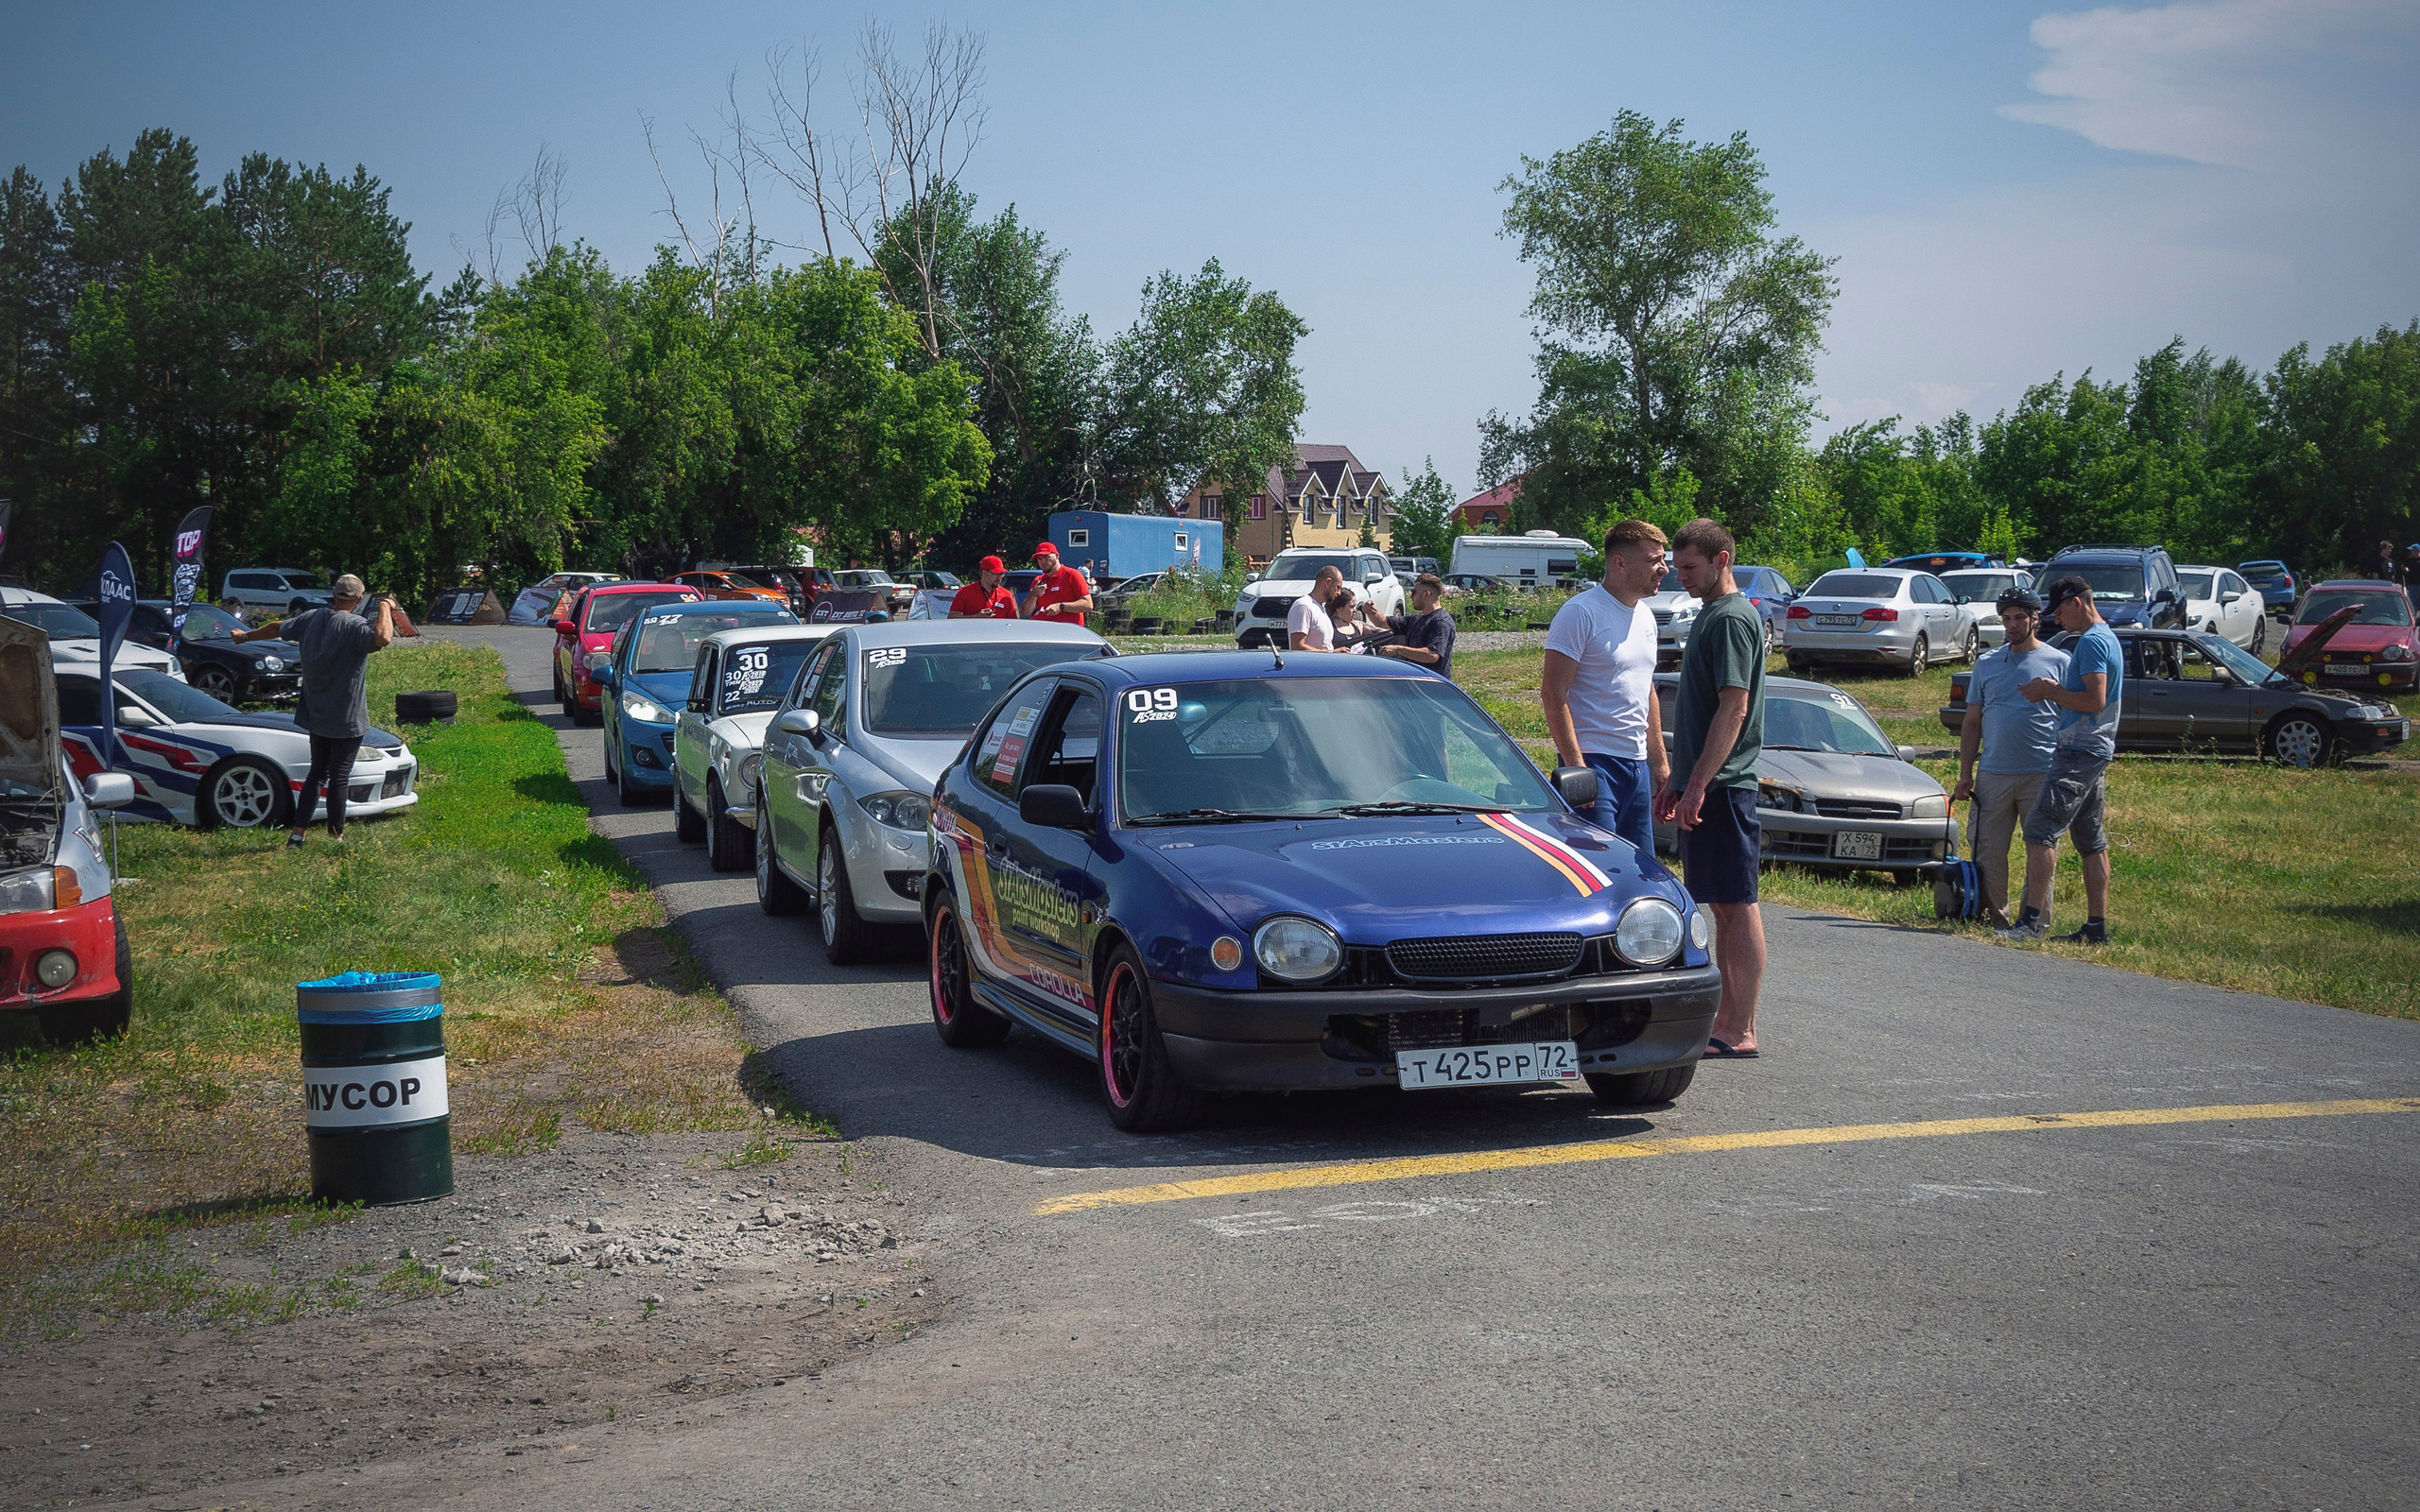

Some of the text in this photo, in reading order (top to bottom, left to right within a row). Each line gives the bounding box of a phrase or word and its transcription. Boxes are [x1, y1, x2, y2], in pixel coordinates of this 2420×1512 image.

[177, 529, 202, 557] TOP
[738, 652, 769, 671] 30
[870, 647, 907, 663] 29
[725, 670, 742, 682] 30
[725, 691, 740, 703] 22
[1128, 688, 1178, 712] 09
[1132, 710, 1177, 723] AS2024
[1866, 846, 1876, 854] 72
[1012, 908, 1061, 943] paint workshop
[1028, 962, 1087, 1007] COROLLA
[1538, 1045, 1568, 1068] 72
[1540, 1069, 1561, 1077] RUS
[305, 1077, 421, 1111] МУСОР
